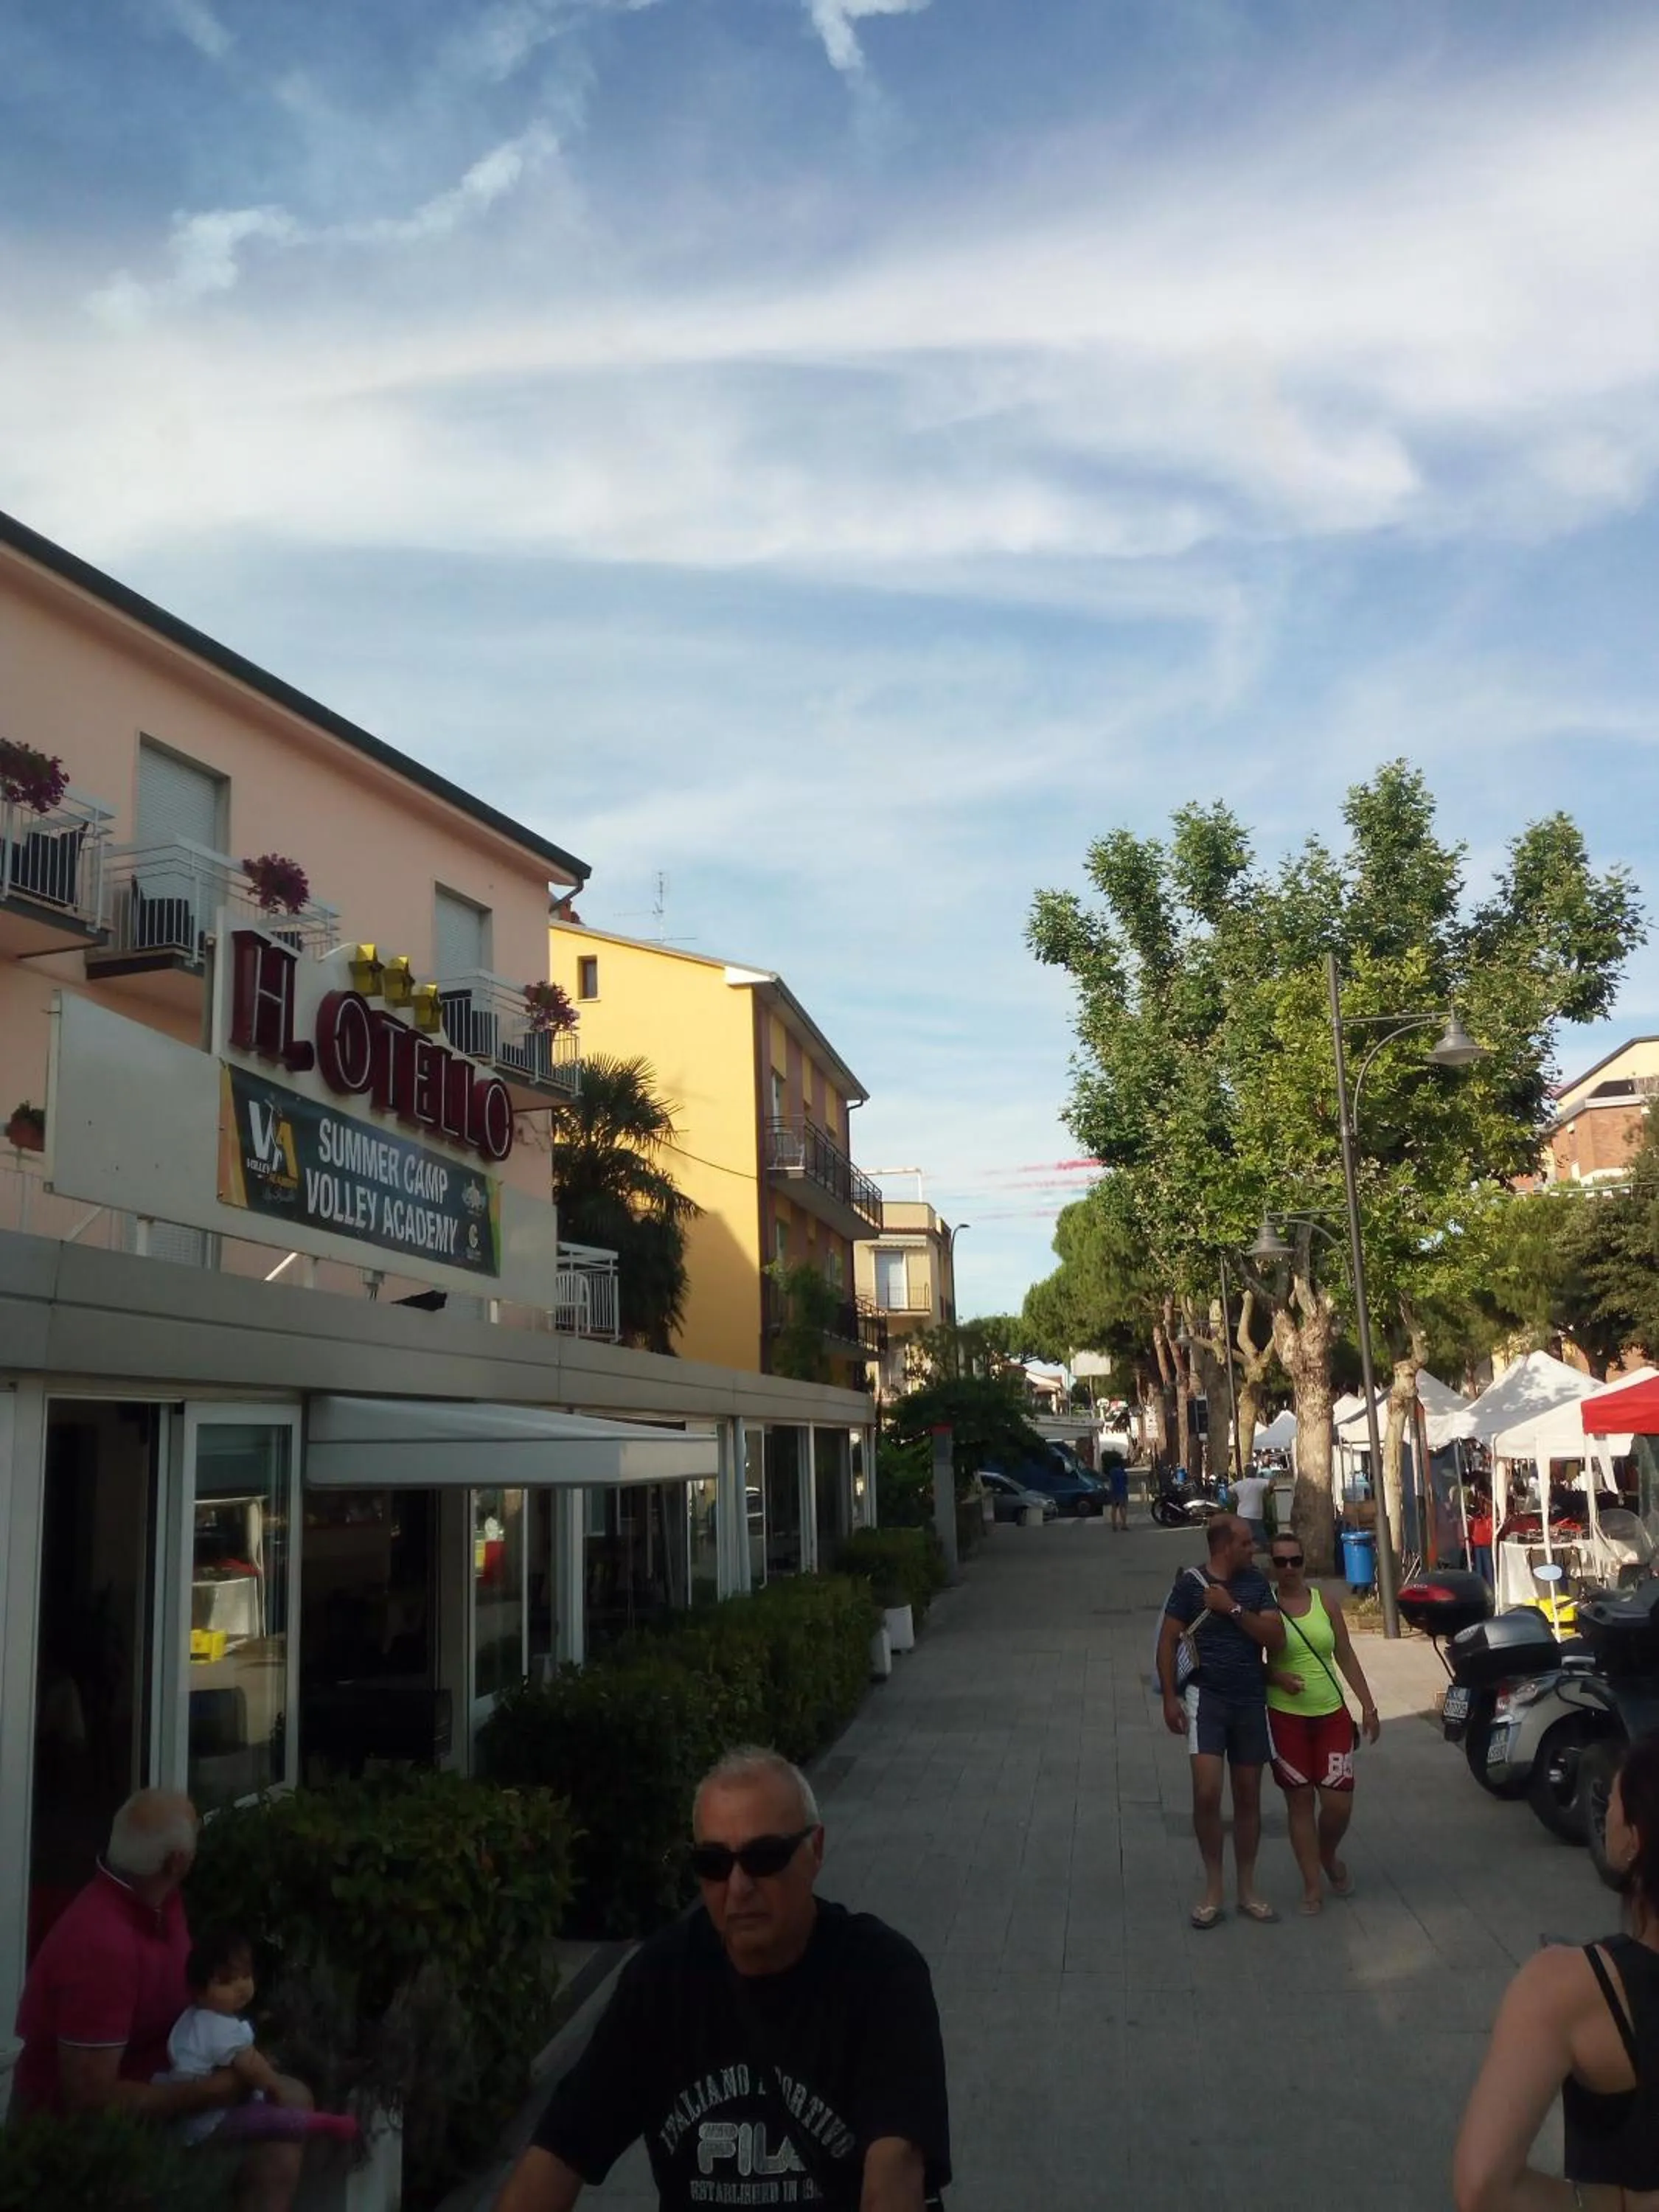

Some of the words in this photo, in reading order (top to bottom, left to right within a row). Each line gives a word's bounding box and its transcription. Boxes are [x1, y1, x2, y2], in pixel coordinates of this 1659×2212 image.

[318, 1117, 400, 1189] SUMMER
[403, 1154, 448, 1204] CAMP
[305, 1167, 378, 1231] VOLLEY
[382, 1195, 459, 1255] ACADEMY
[697, 2121, 807, 2177] FILA
[782, 2180, 799, 2202] IN
